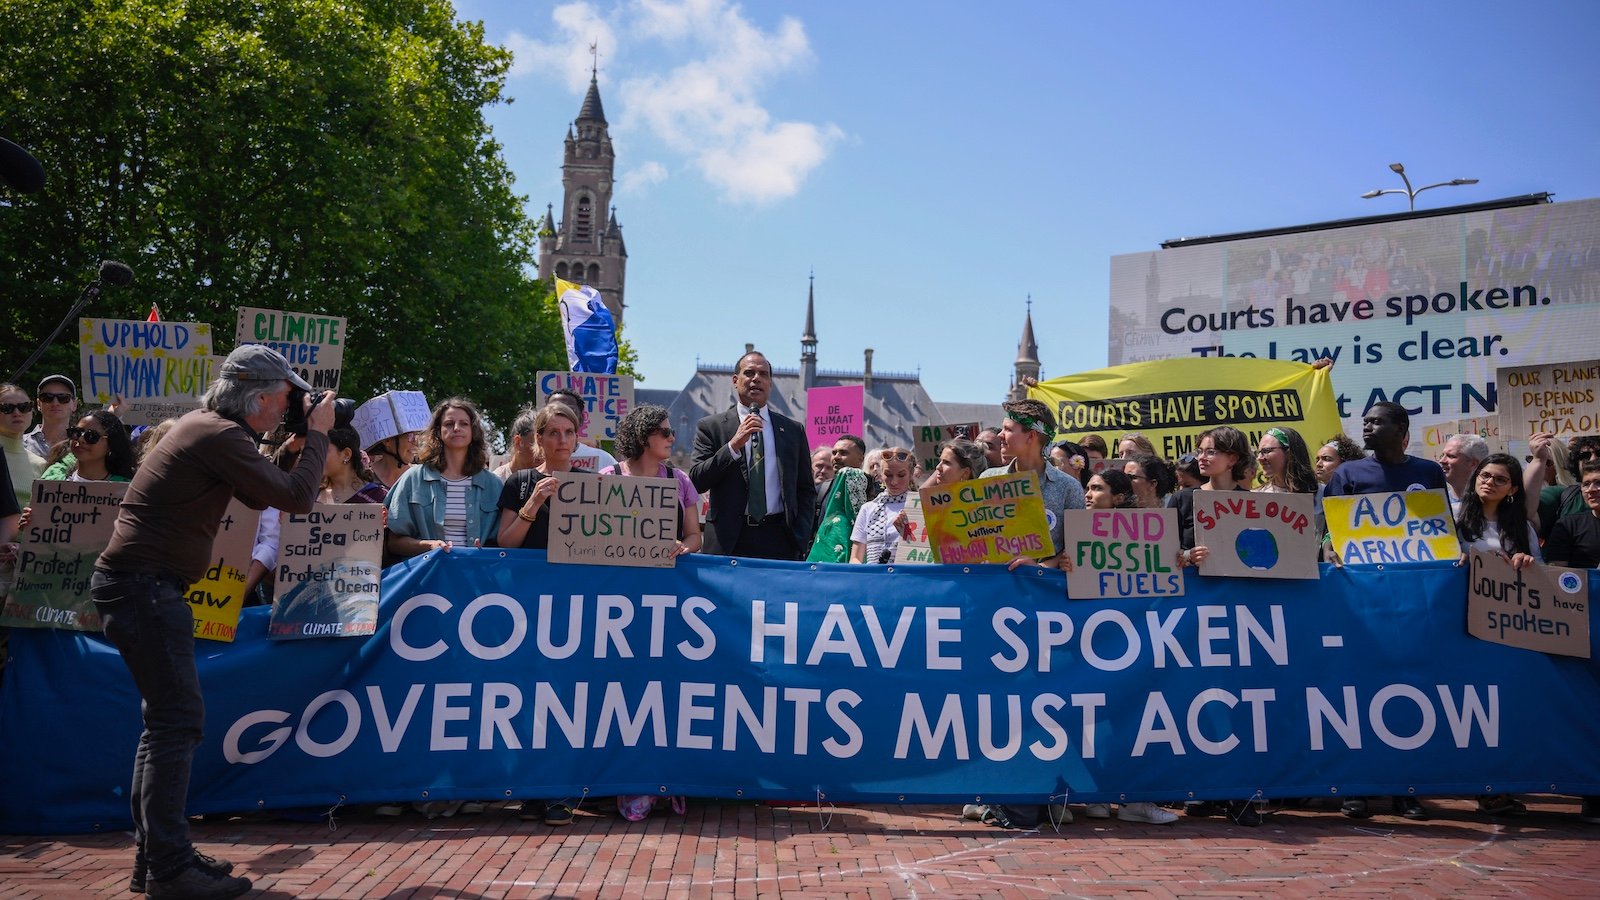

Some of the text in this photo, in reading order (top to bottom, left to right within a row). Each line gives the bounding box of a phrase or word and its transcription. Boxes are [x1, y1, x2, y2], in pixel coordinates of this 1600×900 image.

[1160, 281, 1551, 336] Courts have spoken.
[101, 322, 189, 350] UPHOLD
[1354, 336, 1383, 364] is
[1398, 329, 1509, 362] clear.
[89, 354, 161, 398] HUMAN
[1508, 371, 1541, 388] OUR
[828, 405, 840, 415] DE
[1461, 382, 1497, 414] N
[1523, 389, 1594, 409] DEPENDS
[814, 415, 854, 425] KLIMAAT
[1061, 393, 1300, 430] COURTS HAVE SPOKEN
[1539, 406, 1575, 419] ON THE
[818, 425, 849, 435] IS VOL!
[557, 476, 677, 509] CLIMATE
[930, 493, 951, 506] NO
[959, 479, 1034, 503] CLIMATE
[50, 505, 102, 524] Court
[343, 510, 354, 521] of
[359, 511, 376, 520] the
[951, 503, 1016, 528] JUSTICE
[1196, 498, 1309, 535] SAVE OUR
[1354, 493, 1407, 528] AO
[29, 523, 72, 543] said
[308, 526, 380, 546] Sea Court
[558, 510, 674, 541] JUSTICE
[1091, 512, 1165, 542] END
[1407, 518, 1448, 537] FOR
[285, 543, 323, 556] said
[564, 541, 596, 557] Yumi
[604, 545, 625, 558] GO
[628, 545, 646, 558] GO
[939, 533, 1043, 564] HUMAN RIGHTS
[1343, 539, 1435, 564] AFRICA
[19, 551, 83, 575] Protect
[279, 562, 371, 582] Protect the
[15, 577, 53, 592] Human
[227, 568, 246, 583] the
[334, 578, 379, 593] Ocean
[1099, 571, 1181, 597] FUELS
[1473, 555, 1541, 609] Courts
[1553, 595, 1584, 612] have
[36, 606, 77, 625] CLIMATE
[1488, 609, 1570, 640] spoken
[202, 621, 236, 640] ACTION
[303, 622, 343, 635] CLIMATE
[389, 592, 717, 662] COURTS
[749, 600, 963, 671] HAVE
[989, 604, 1289, 673] SPOKEN
[222, 679, 1500, 765] GOVERNMENTS MUST ACT NOW
